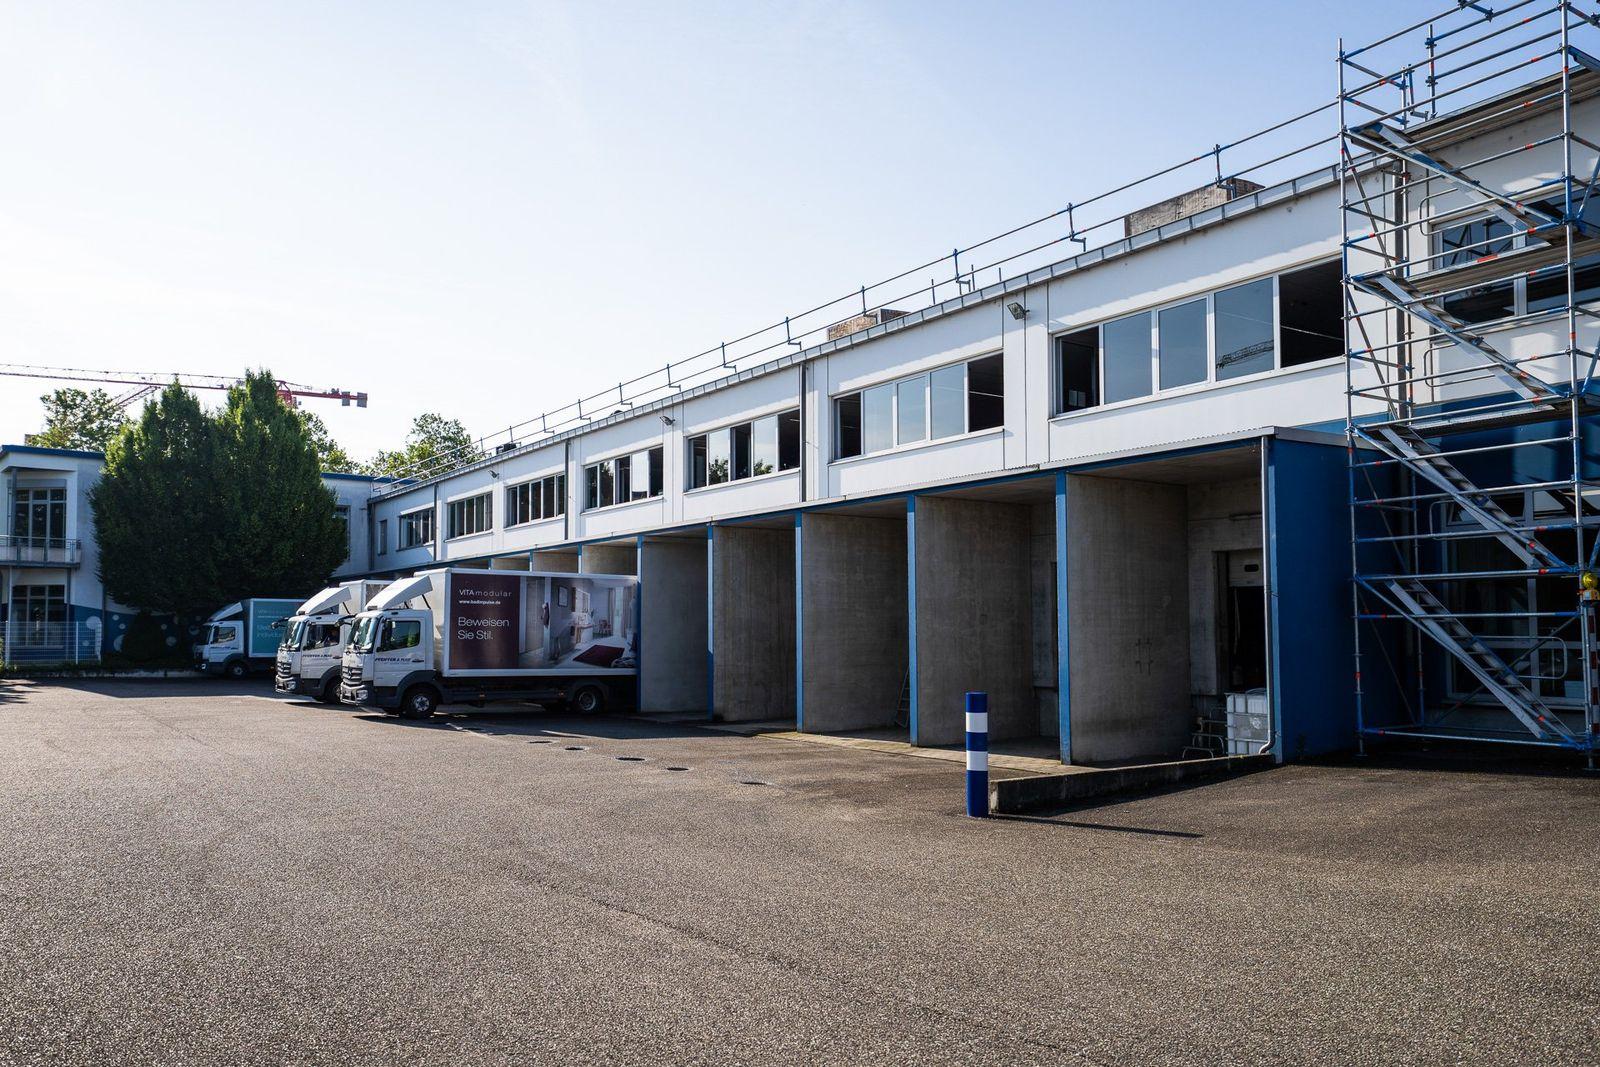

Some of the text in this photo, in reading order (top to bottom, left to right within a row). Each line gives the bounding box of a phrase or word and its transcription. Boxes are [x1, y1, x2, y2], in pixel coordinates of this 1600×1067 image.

[458, 617, 510, 627] Beweisen
[457, 630, 494, 640] Sie Stil.
